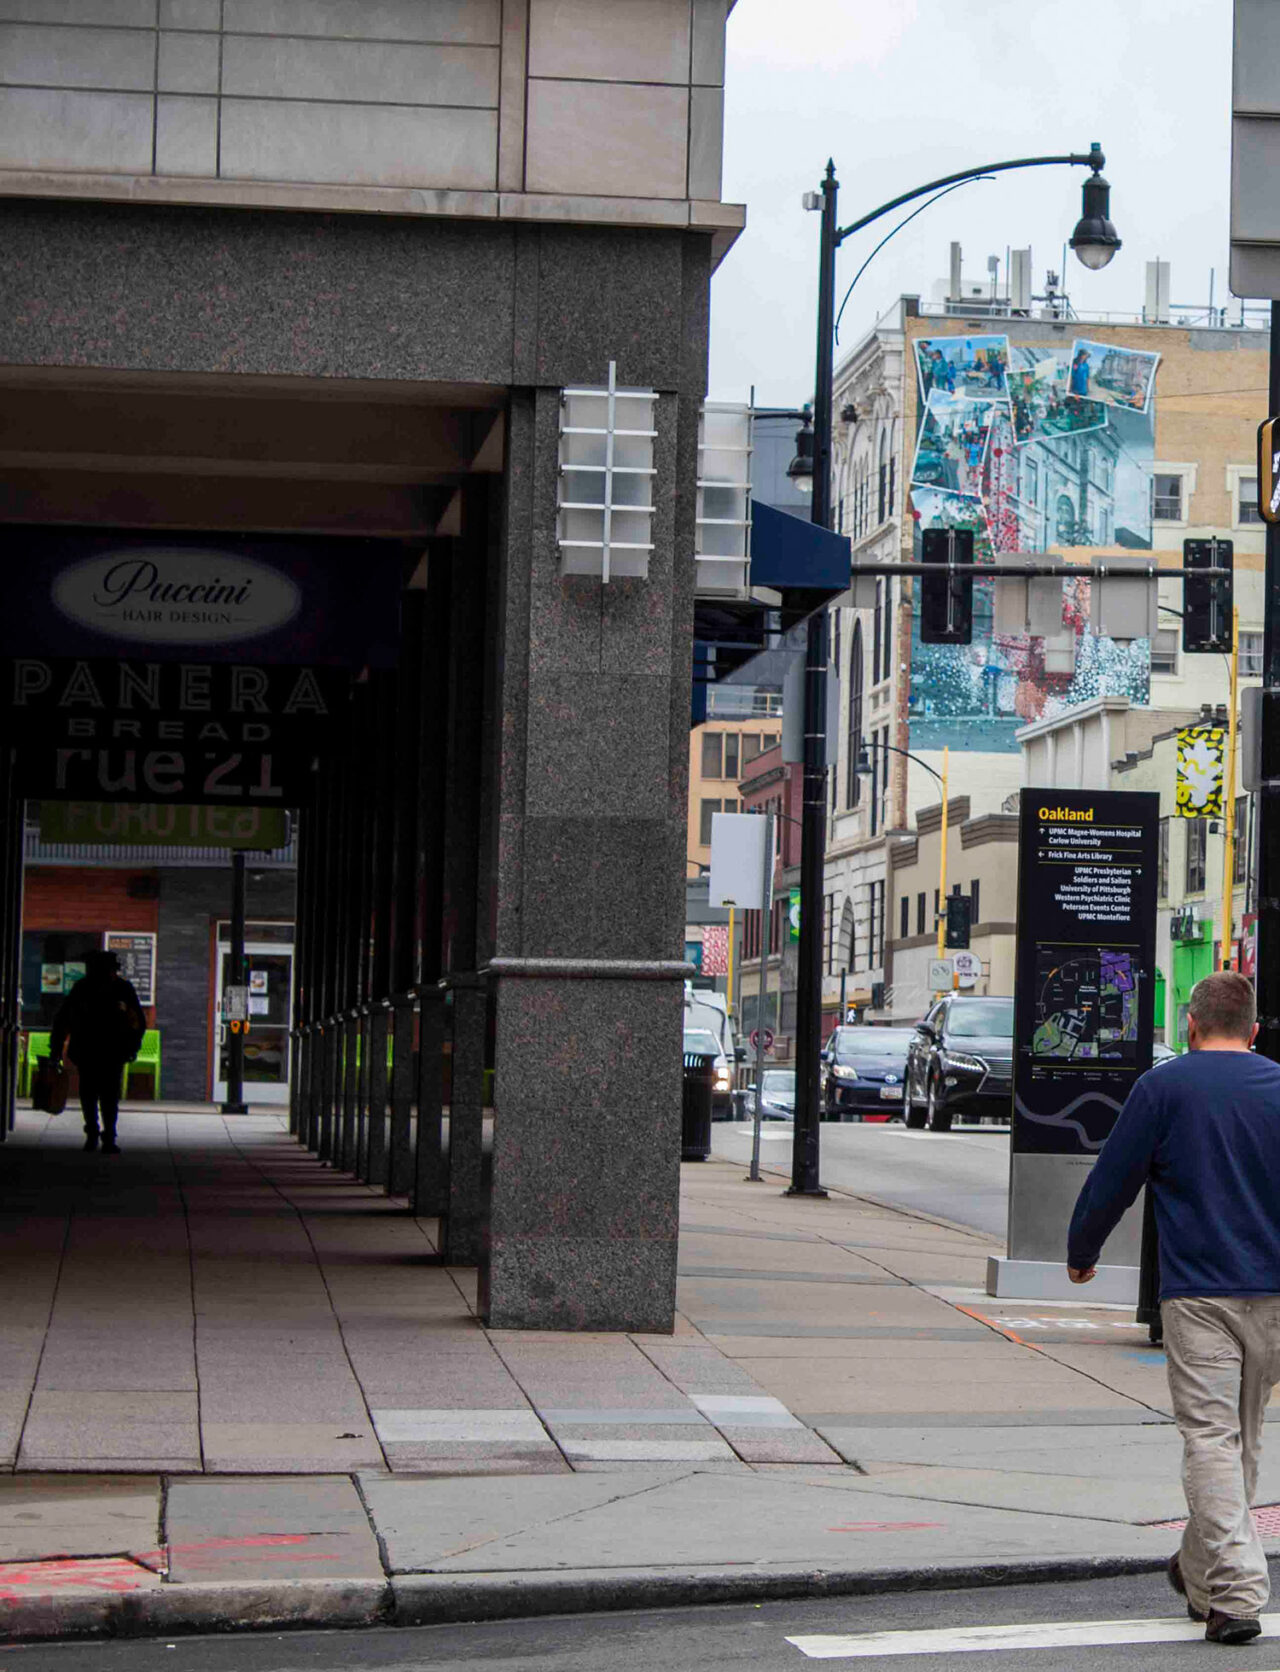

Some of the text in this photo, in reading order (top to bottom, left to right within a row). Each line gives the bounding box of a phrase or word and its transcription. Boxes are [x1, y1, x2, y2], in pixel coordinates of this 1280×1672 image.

[93, 559, 252, 607] Puccini
[122, 608, 232, 625] HAIR DESIGN
[12, 658, 329, 715] PANERA
[67, 717, 272, 742] BREAD
[56, 747, 284, 798] rue21
[1039, 807, 1094, 821] Oakland
[1116, 830, 1142, 838] Hospital
[1070, 837, 1101, 847] University
[1064, 851, 1076, 859] Fine
[1091, 852, 1112, 861] Library
[1093, 867, 1132, 876] Presbyterian
[1060, 884, 1091, 893] University
[1099, 886, 1132, 895] Pittsburgh
[1081, 894, 1114, 903] Psychiatric
[1062, 903, 1089, 911] Petersen
[1110, 904, 1131, 912] Center
[1097, 913, 1130, 921] Montefiore
